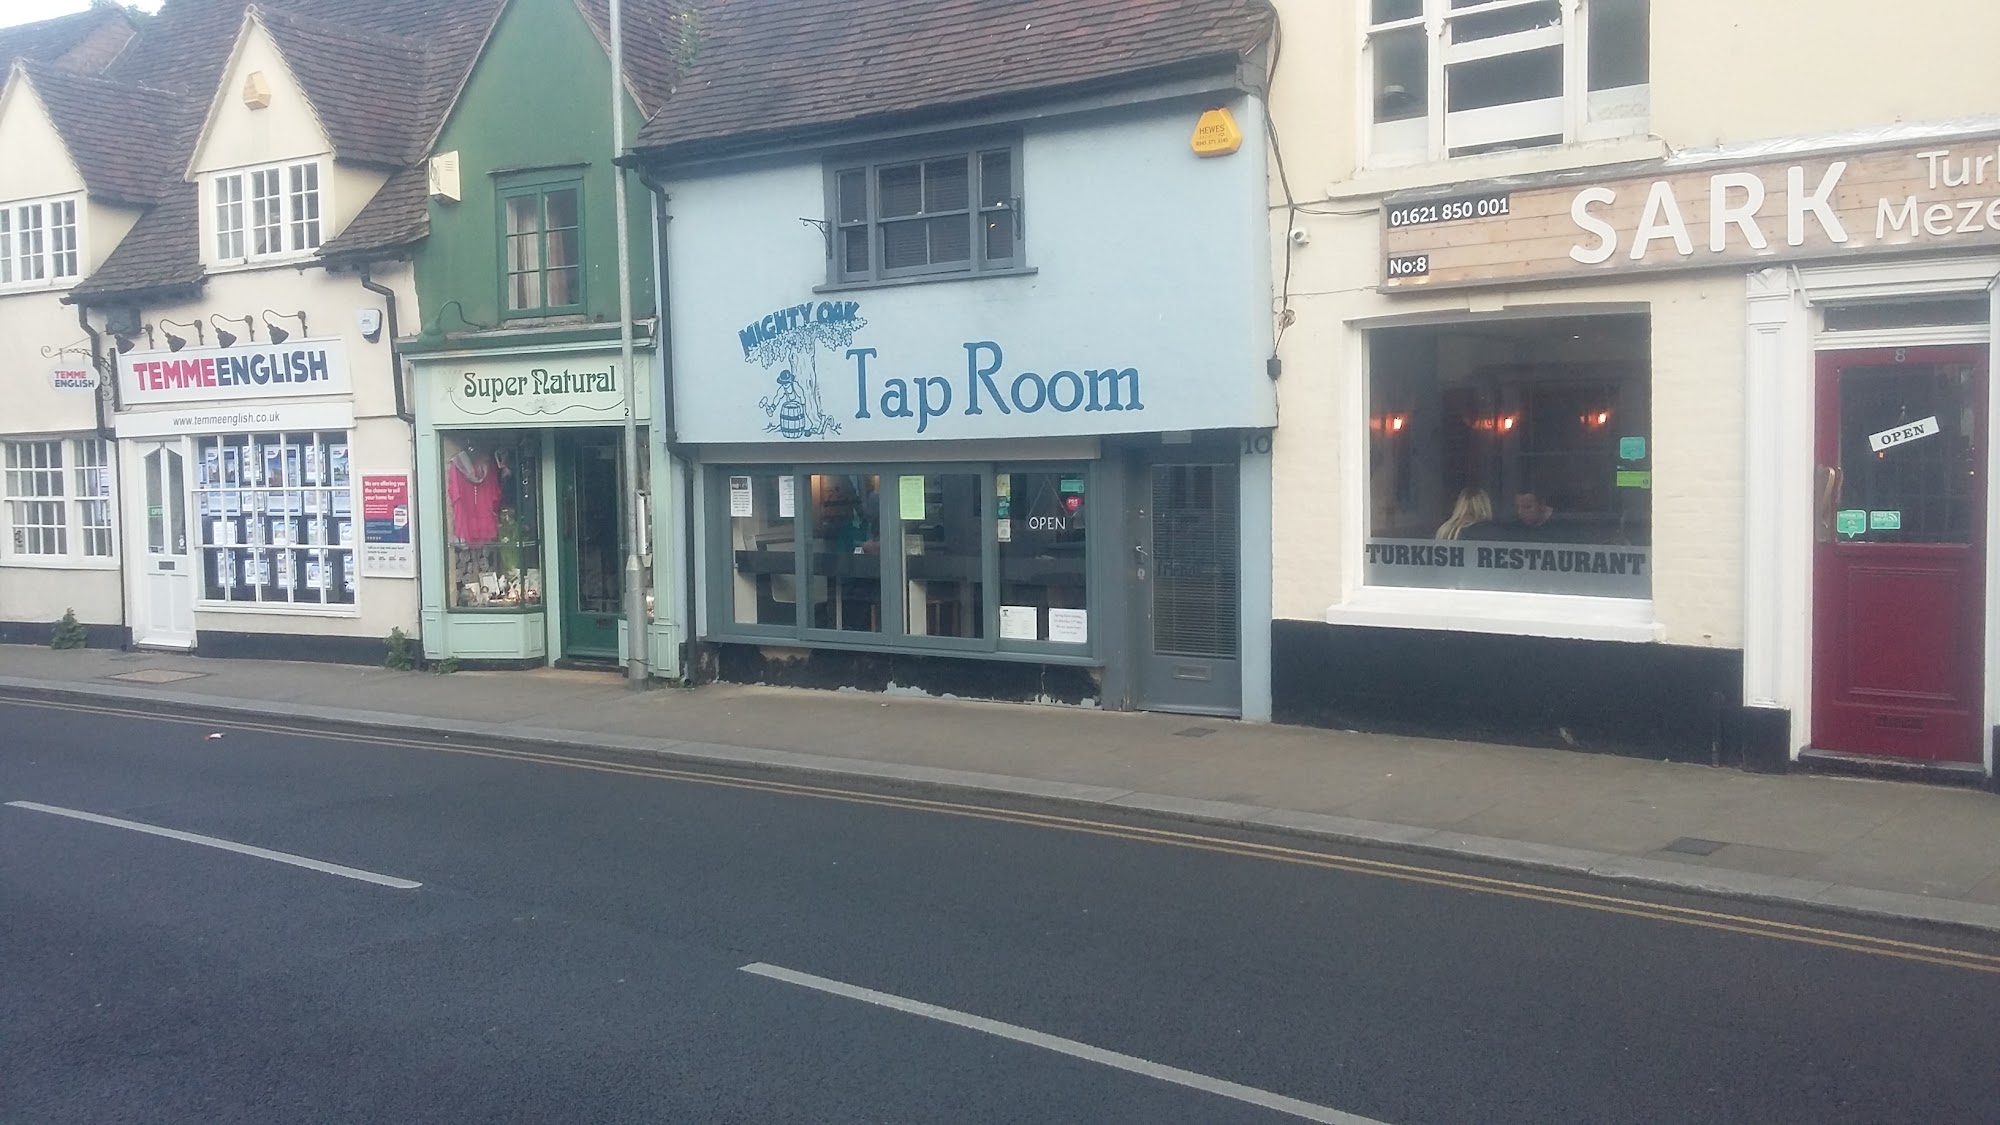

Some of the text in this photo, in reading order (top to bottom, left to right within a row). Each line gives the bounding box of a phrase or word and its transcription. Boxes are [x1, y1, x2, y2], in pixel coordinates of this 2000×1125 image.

[1199, 124, 1226, 135] HEWES
[1391, 197, 1509, 226] 01621 850 001
[1569, 161, 1849, 265] SARK
[1390, 256, 1427, 275] No:8
[738, 300, 861, 357] MIGHTY OAK
[1894, 348, 1906, 363] 8
[54, 370, 87, 379] TEMME
[54, 379, 95, 388] ENGLISH
[463, 365, 617, 403] Super Natural
[845, 340, 1145, 434] Tap Room
[172, 410, 281, 427] www.temmeenglish.co.uk
[1243, 434, 1272, 455] 10
[1880, 423, 1925, 445] OPEN
[1028, 516, 1066, 530] OPEN
[1365, 543, 1646, 575] TURKISH RESTAURANT
